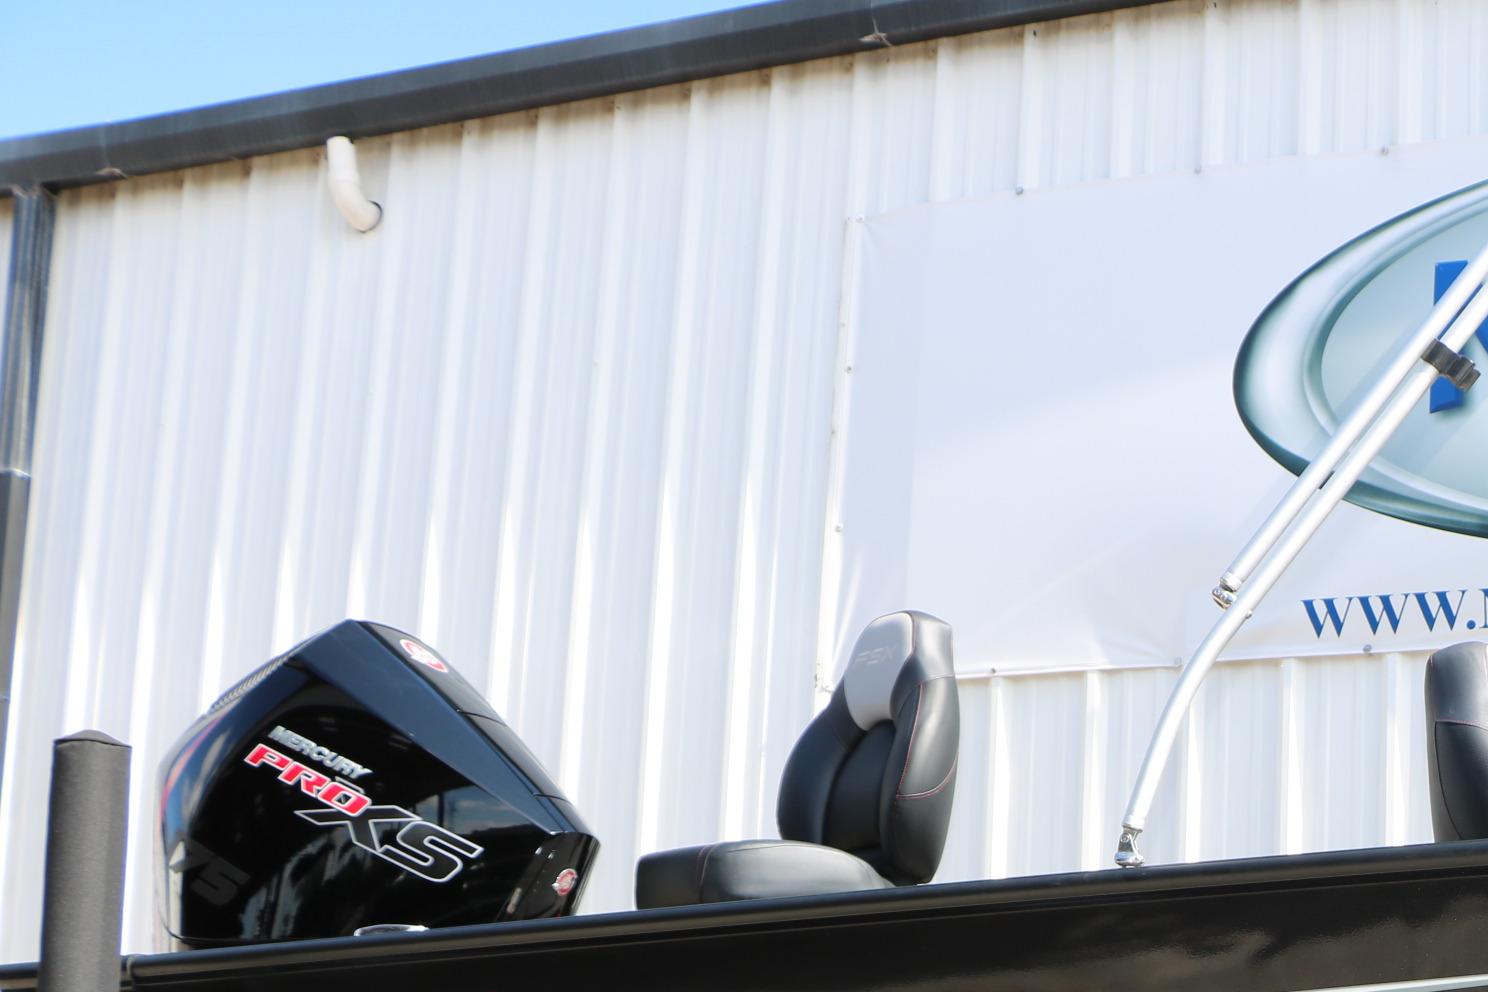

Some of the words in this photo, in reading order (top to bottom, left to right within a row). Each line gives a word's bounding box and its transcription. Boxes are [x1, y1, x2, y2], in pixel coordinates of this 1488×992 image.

[244, 743, 372, 817] PRO
[267, 725, 373, 780] MERCURY
[294, 805, 484, 883] XS
